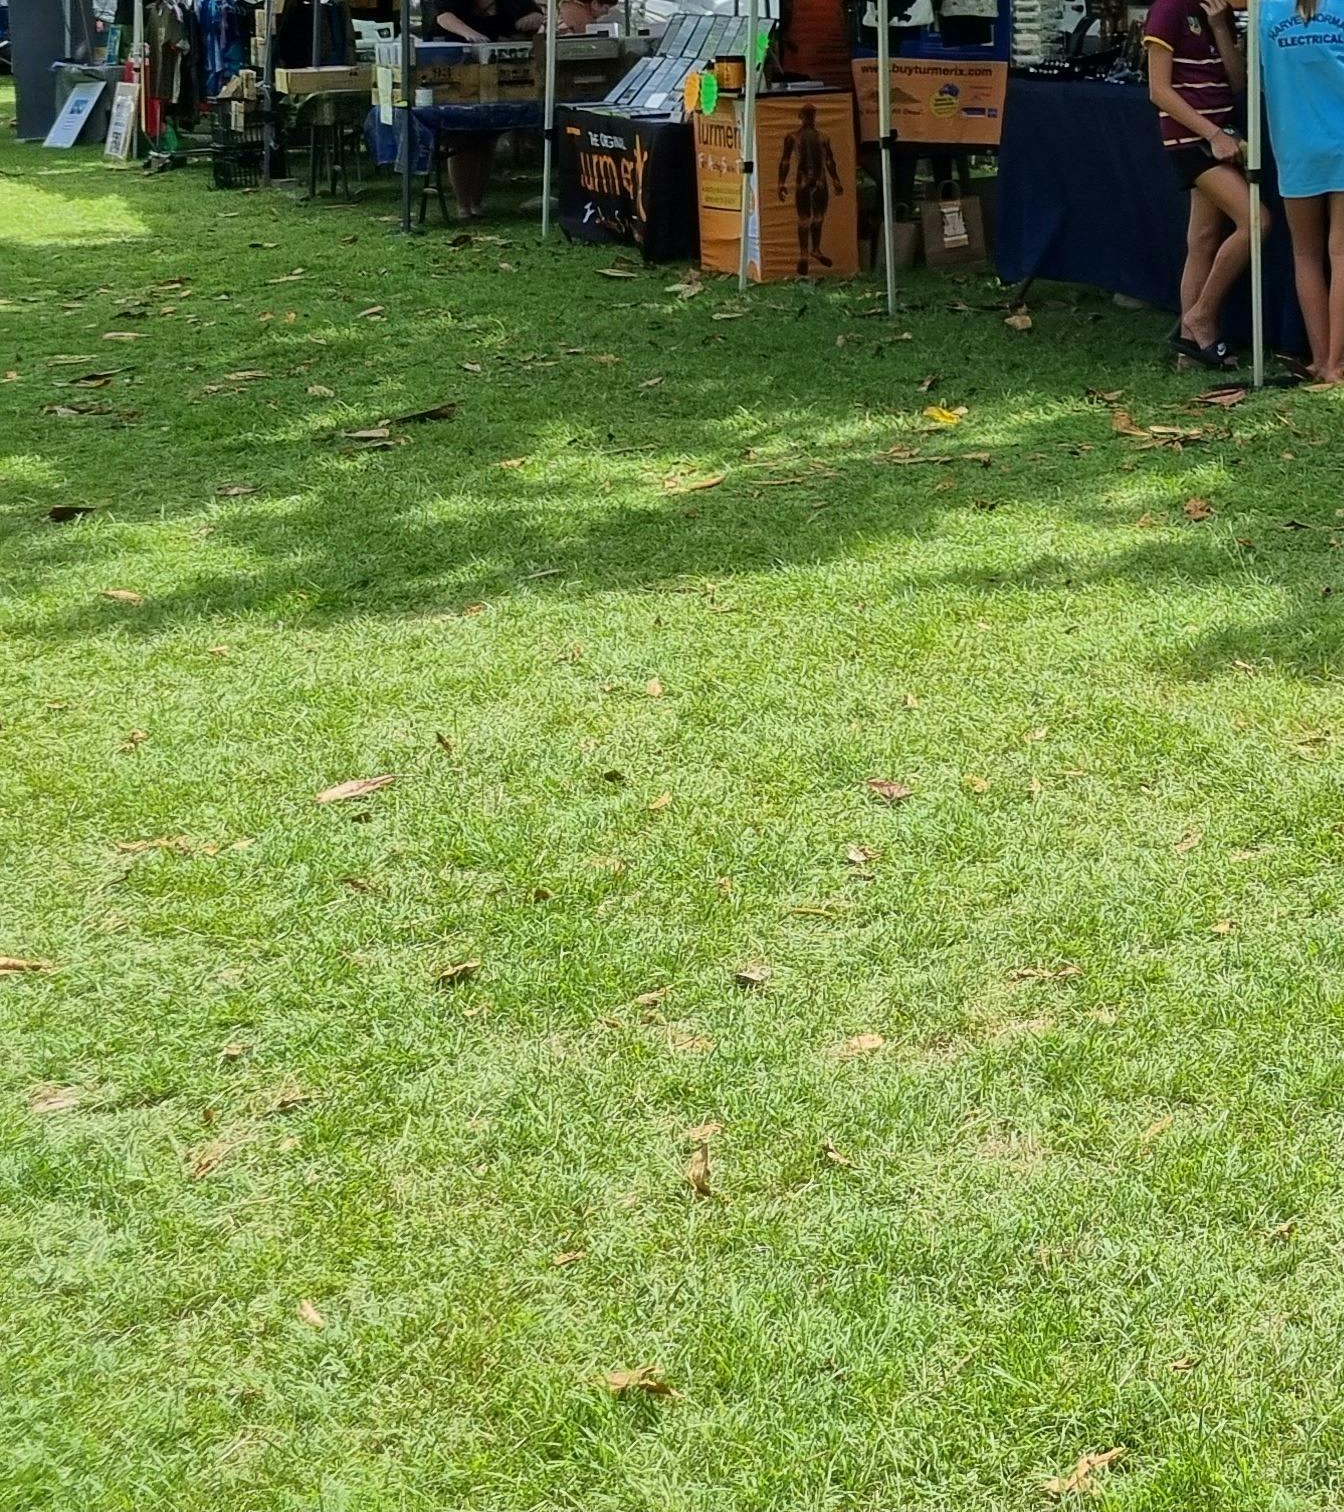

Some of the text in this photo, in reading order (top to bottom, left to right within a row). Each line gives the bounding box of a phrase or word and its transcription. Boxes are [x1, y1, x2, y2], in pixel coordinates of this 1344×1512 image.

[1269, 14, 1304, 41] HARVE
[1278, 33, 1344, 48] ELECTRICAL
[861, 63, 993, 78] ww.buyturmerix.com
